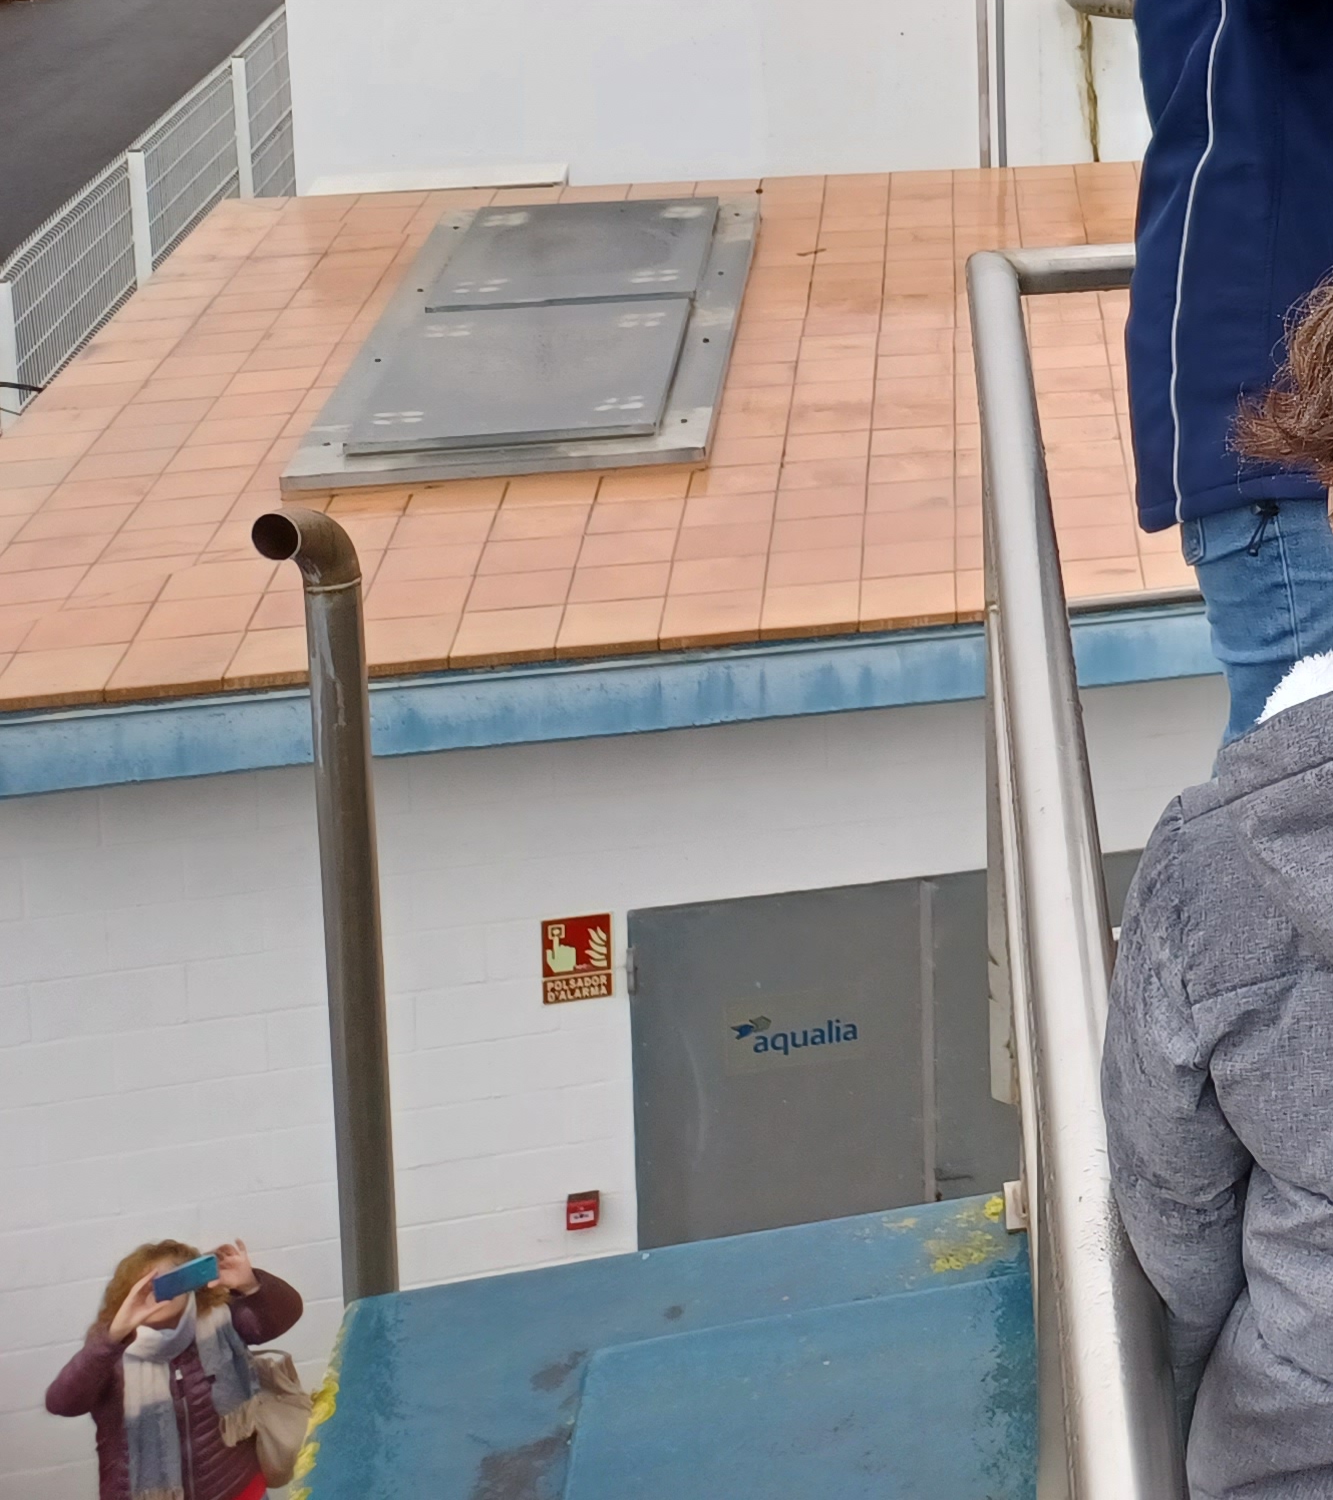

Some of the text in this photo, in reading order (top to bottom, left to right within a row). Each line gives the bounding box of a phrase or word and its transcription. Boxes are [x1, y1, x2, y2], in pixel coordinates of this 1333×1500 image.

[546, 975, 607, 992] POLSADOR
[547, 986, 608, 1003] D'ALARMA
[753, 1019, 858, 1055] aqualia
